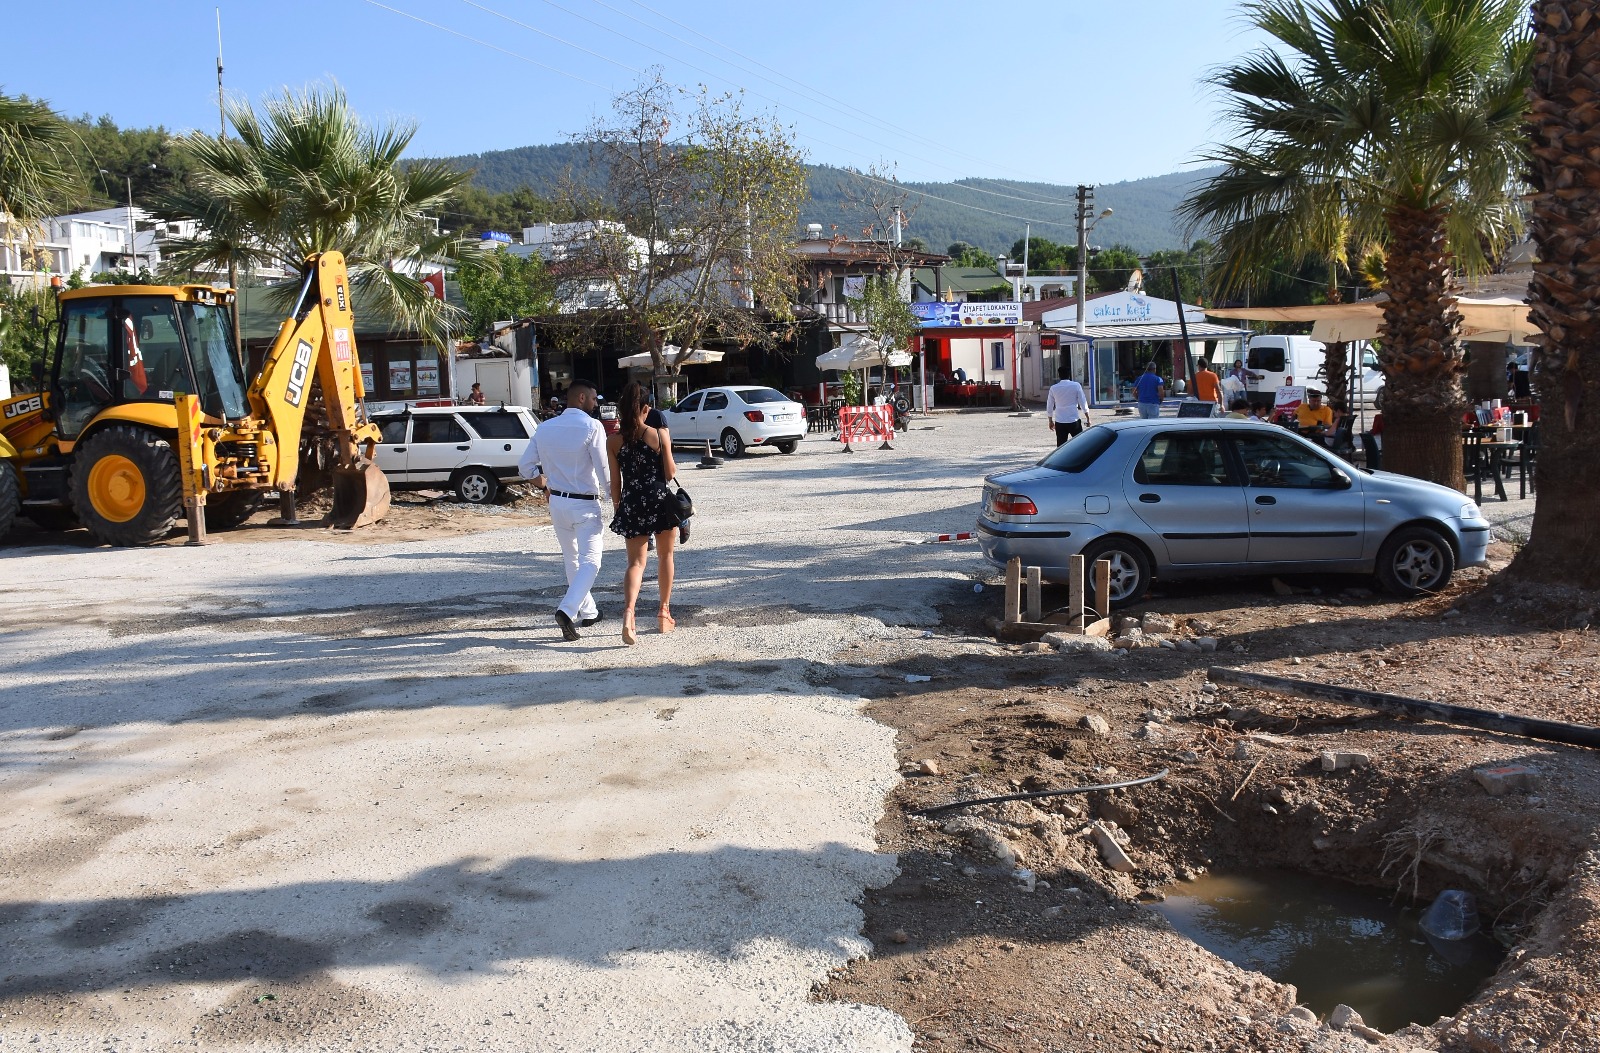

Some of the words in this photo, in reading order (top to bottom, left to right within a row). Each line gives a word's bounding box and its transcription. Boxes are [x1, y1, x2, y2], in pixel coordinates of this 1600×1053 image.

[337, 286, 346, 307] 4CX
[963, 304, 986, 313] ZİYAFET
[287, 341, 313, 405] JCB
[5, 396, 42, 418] JCB
